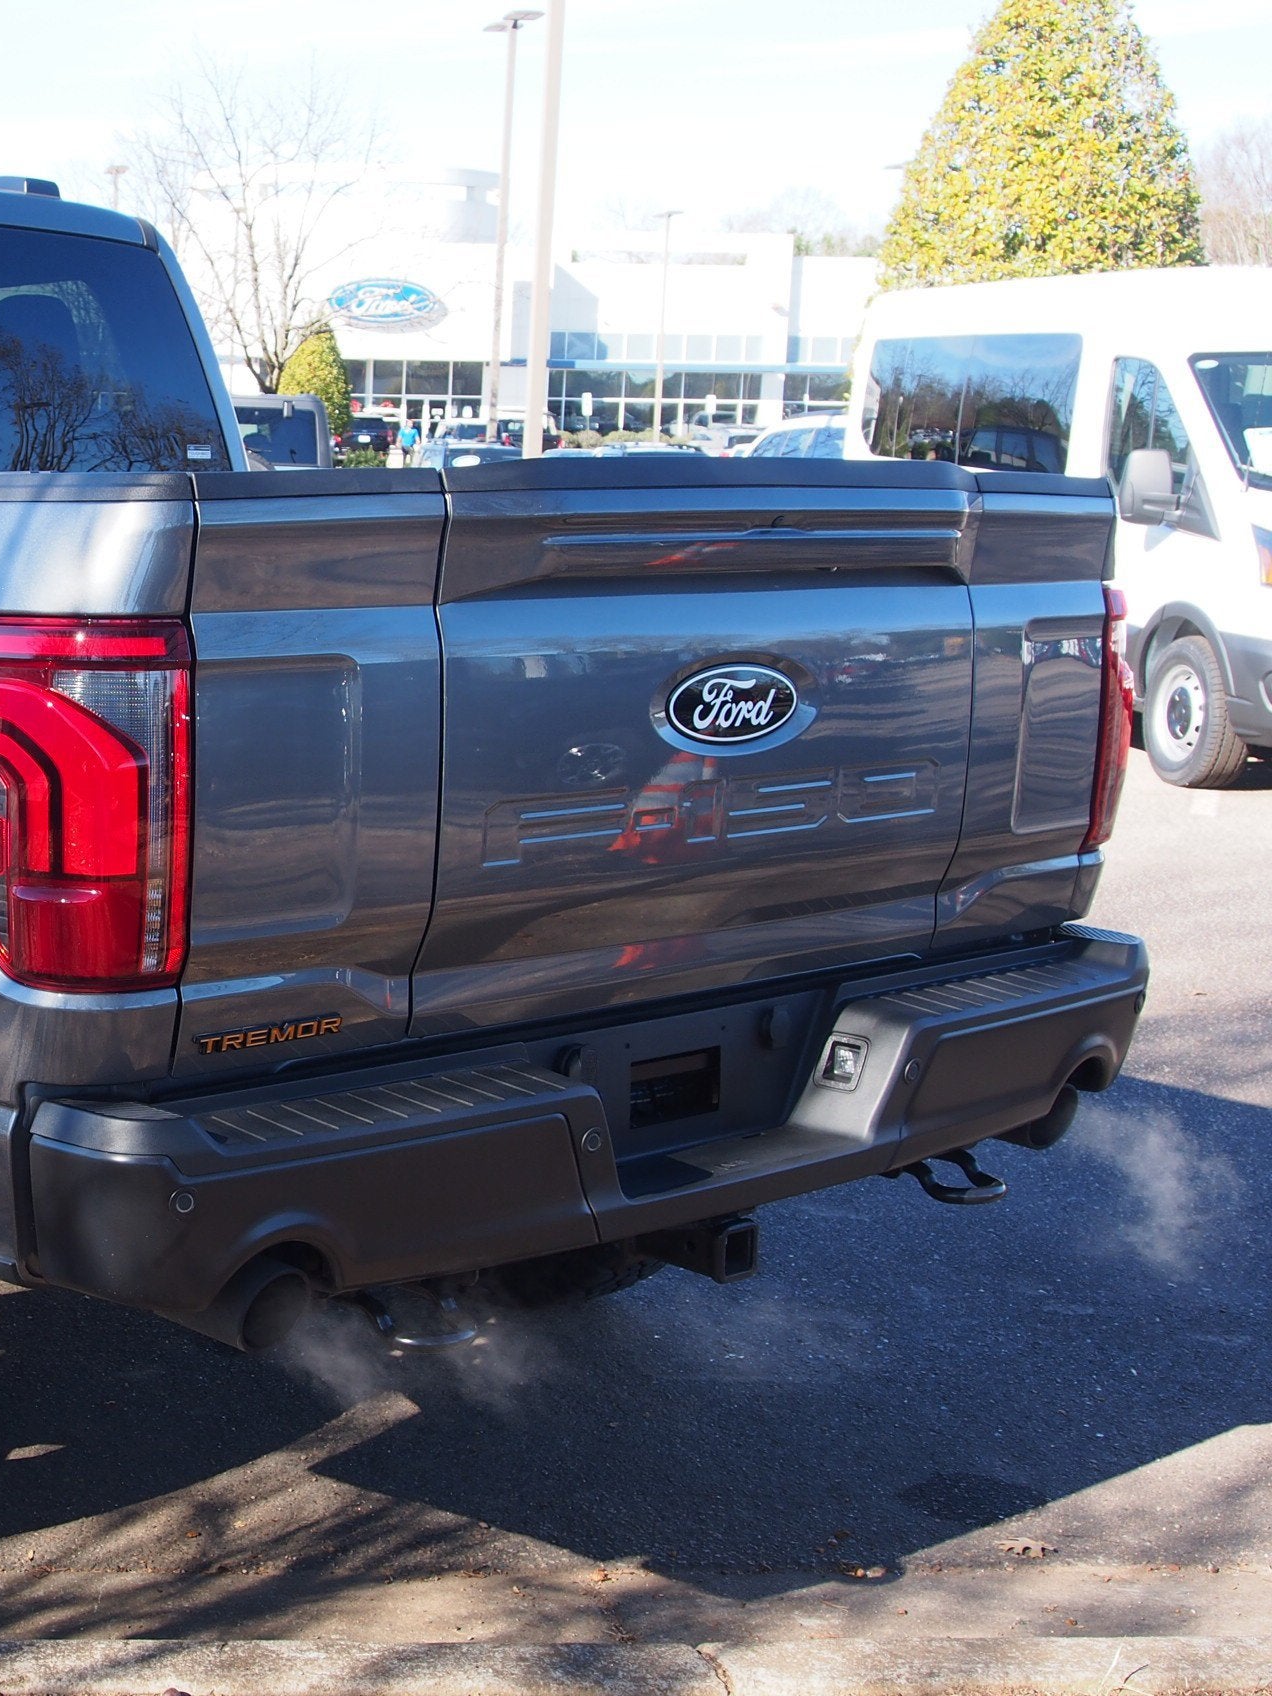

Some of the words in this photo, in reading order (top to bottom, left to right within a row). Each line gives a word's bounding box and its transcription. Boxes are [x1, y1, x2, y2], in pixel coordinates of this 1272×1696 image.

[350, 287, 432, 315] Ford
[692, 677, 776, 728] Ford
[481, 757, 940, 868] F-150
[199, 1016, 343, 1055] TREMOR
